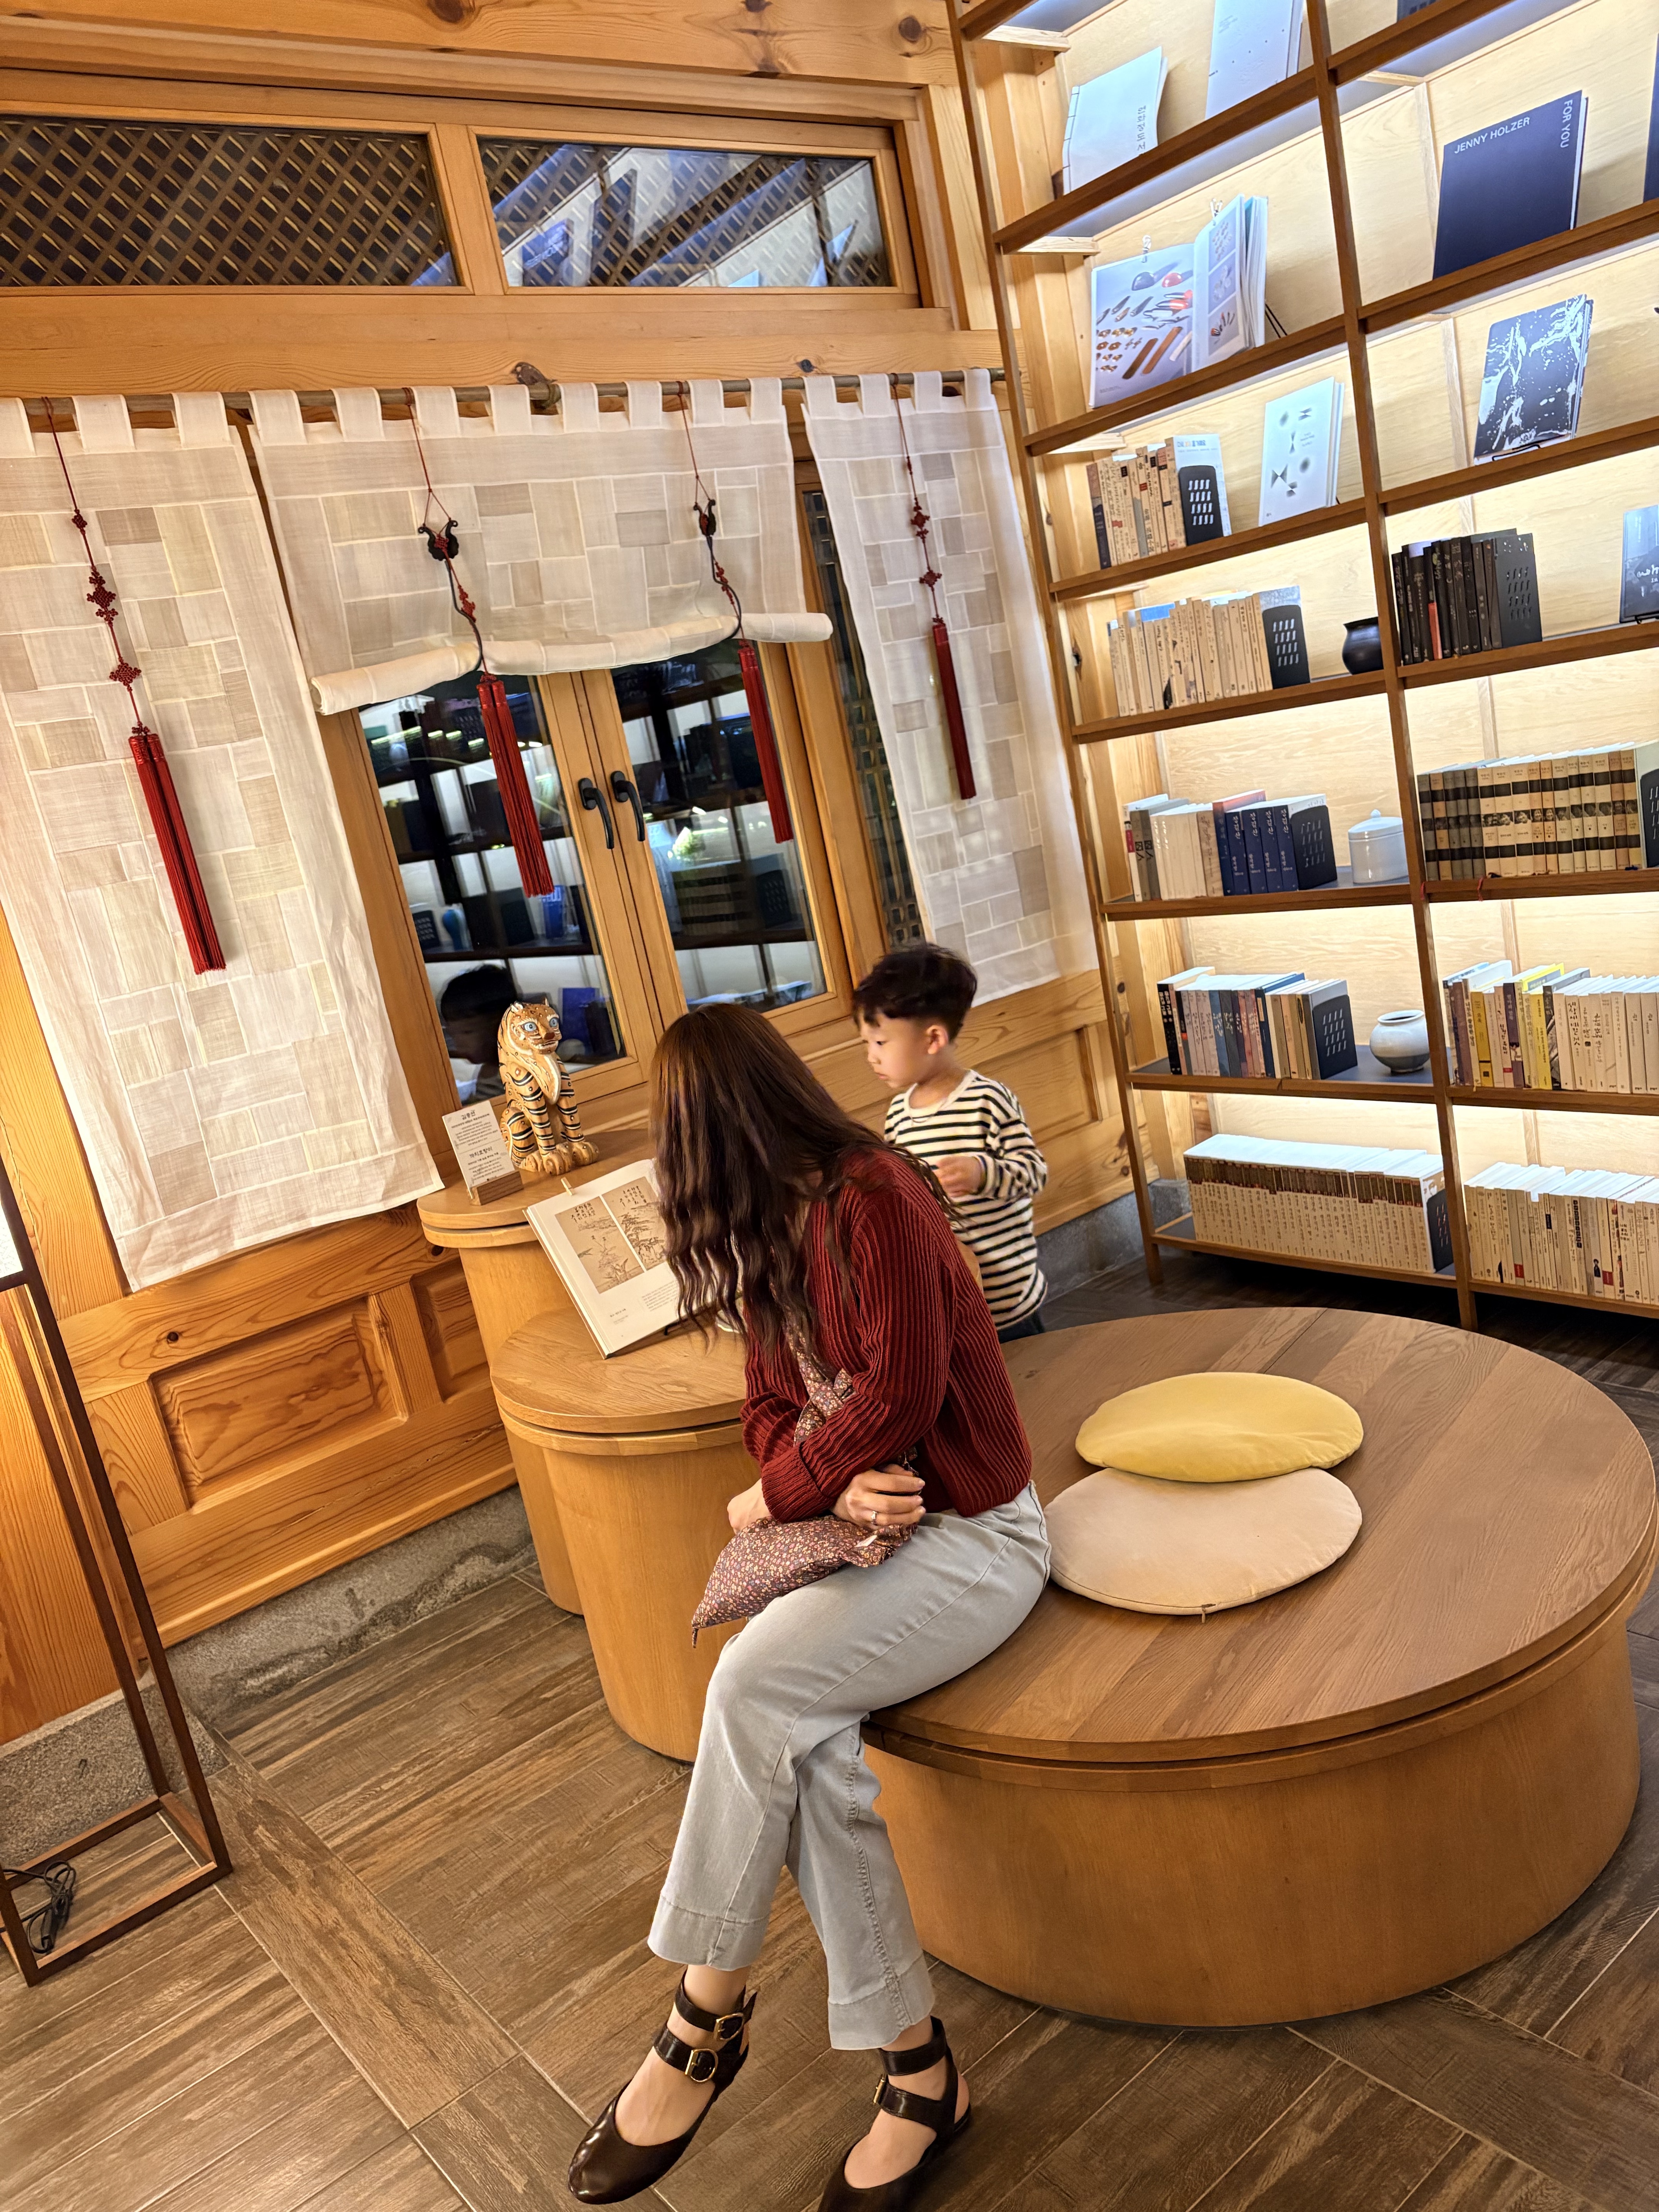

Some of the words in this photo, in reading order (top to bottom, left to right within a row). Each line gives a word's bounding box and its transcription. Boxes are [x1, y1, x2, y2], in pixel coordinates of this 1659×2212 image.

[1562, 99, 1573, 123] FOR
[1454, 133, 1488, 154] JENNY
[1490, 117, 1530, 139] HOLZER
[1560, 124, 1571, 148] YOU
